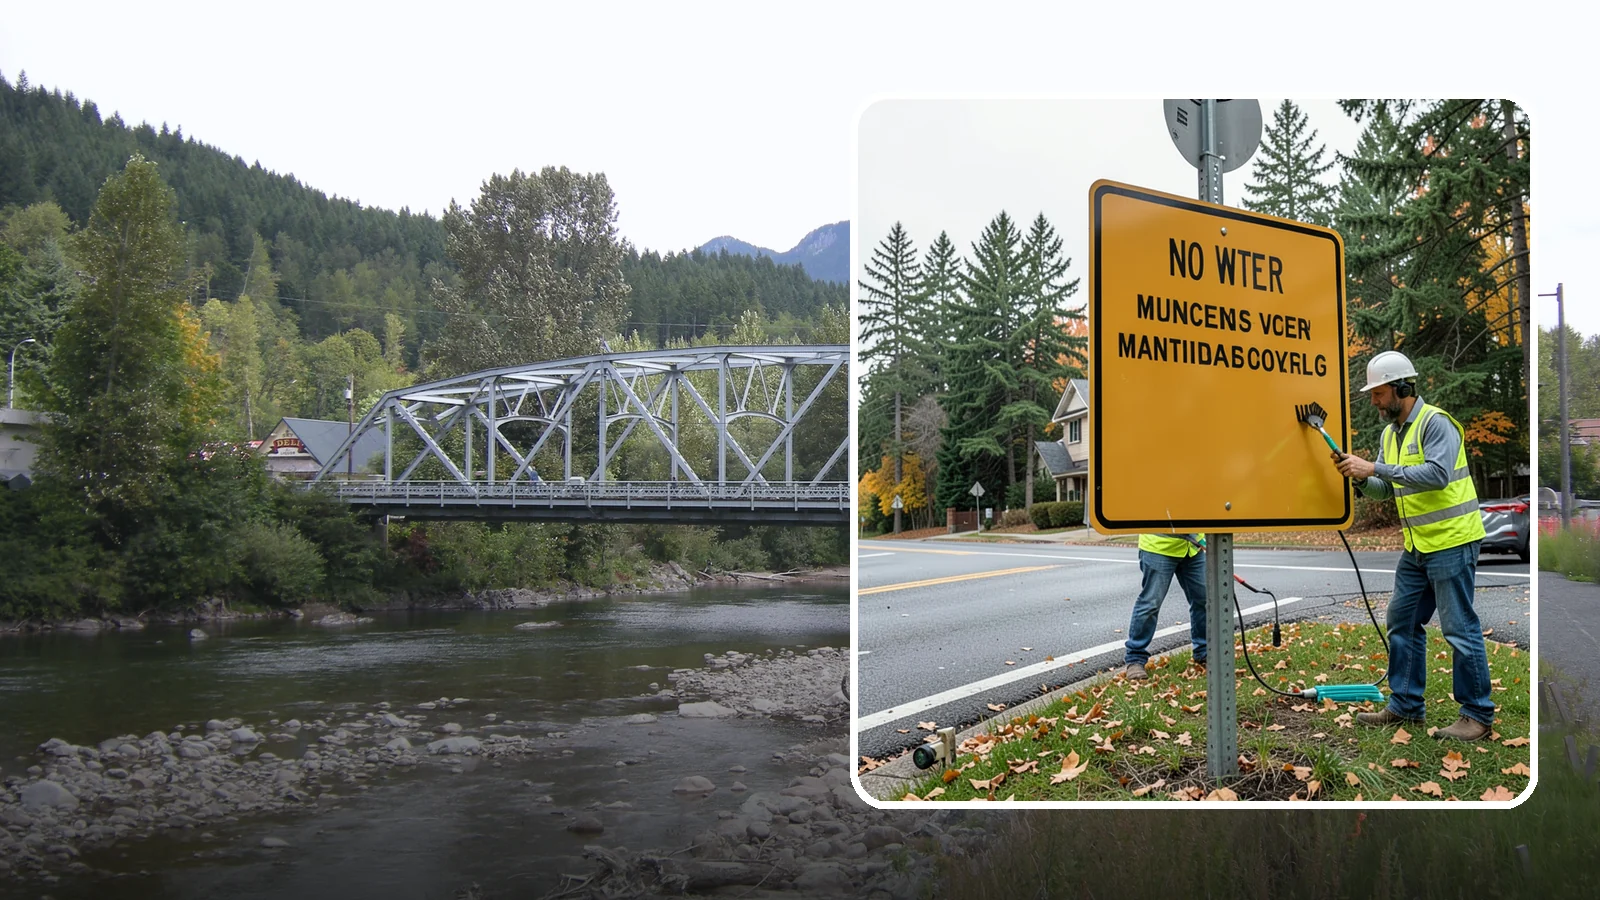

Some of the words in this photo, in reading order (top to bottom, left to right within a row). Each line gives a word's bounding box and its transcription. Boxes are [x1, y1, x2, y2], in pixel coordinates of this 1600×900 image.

[1169, 237, 1204, 281] NO
[1215, 245, 1283, 294] WTER
[1137, 294, 1251, 333] MUNCENS
[277, 439, 300, 447] DELI
